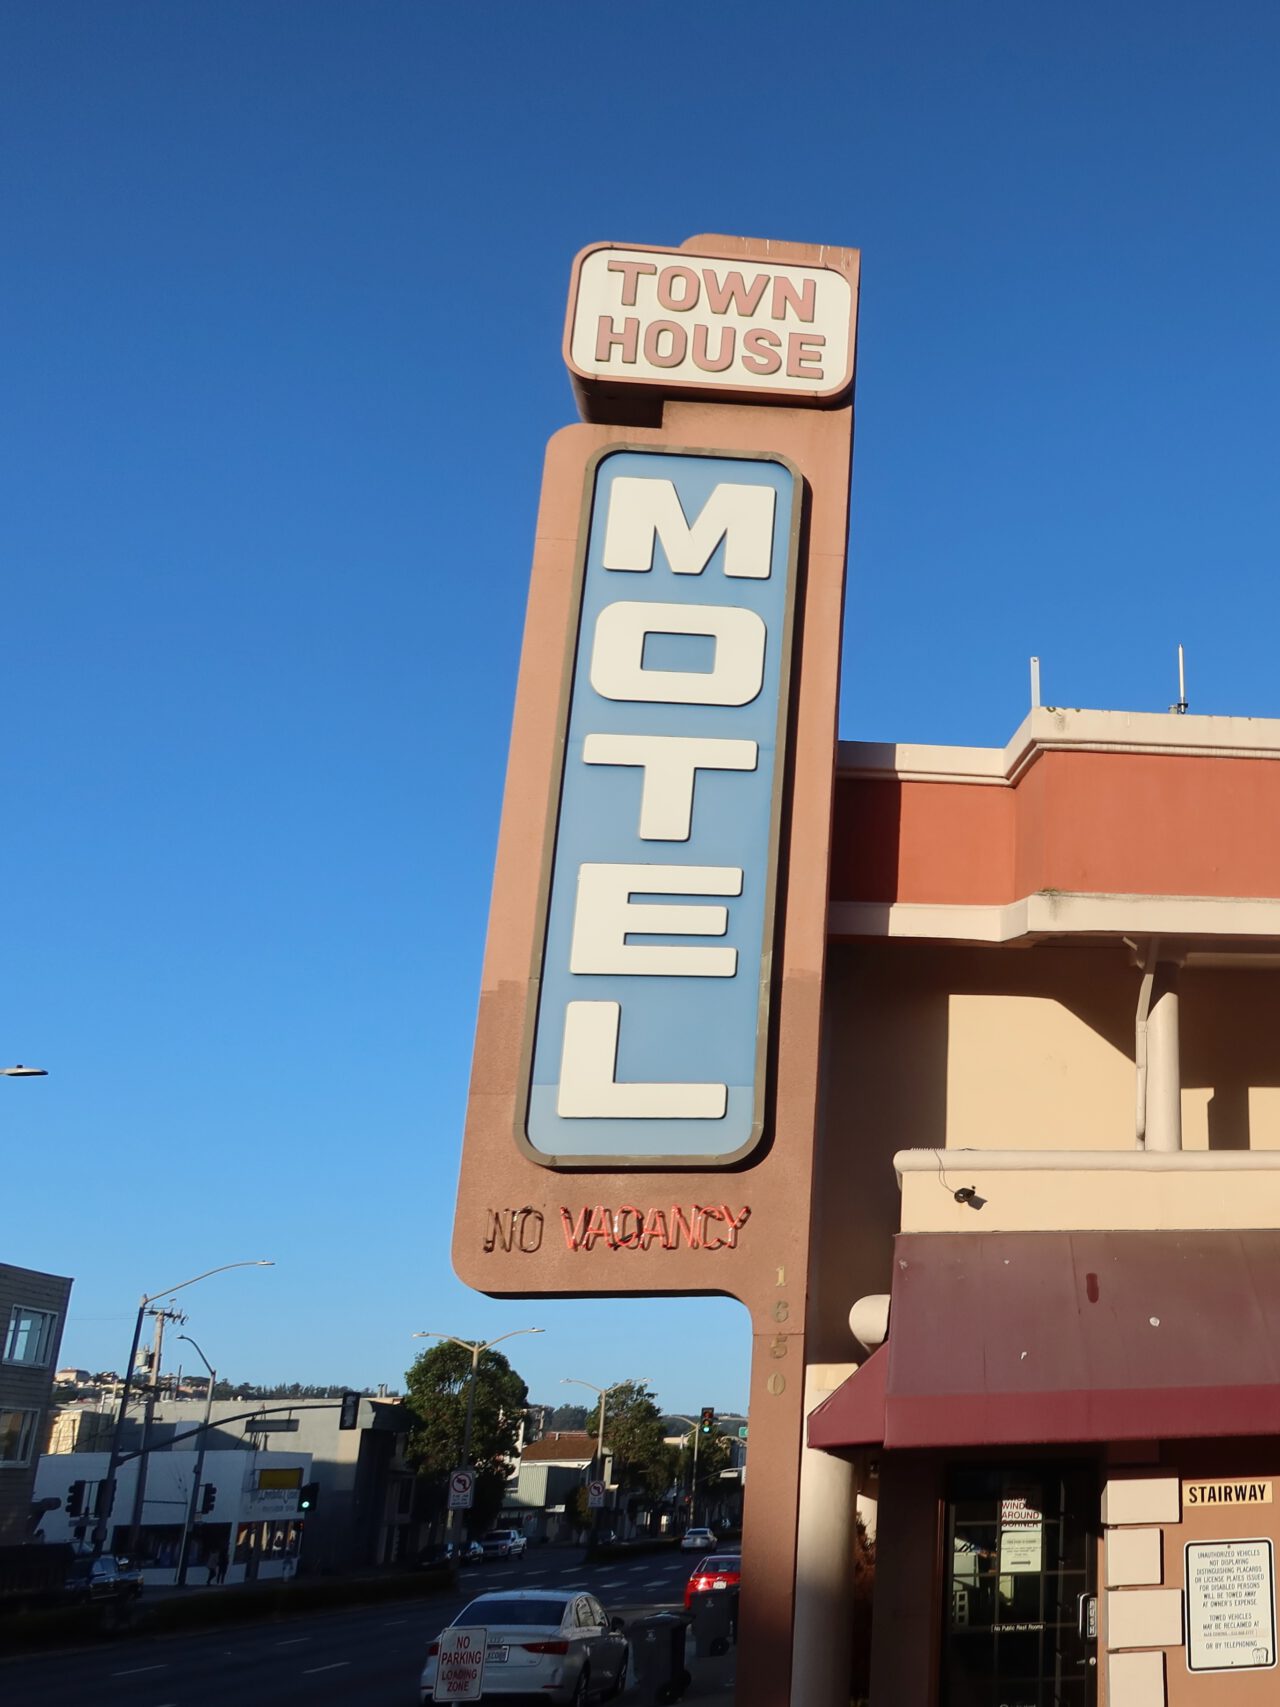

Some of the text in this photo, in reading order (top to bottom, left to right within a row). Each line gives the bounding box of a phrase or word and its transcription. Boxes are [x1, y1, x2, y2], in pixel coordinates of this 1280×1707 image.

[607, 259, 816, 323] TOWN
[594, 315, 827, 380] HOUSE
[557, 476, 777, 1119] MOTEL
[484, 1203, 753, 1254] NO VACANCY
[766, 1264, 789, 1397] 1650
[1189, 1484, 1266, 1504] STAIRWAY
[1001, 1511, 1040, 1520] AROUND
[1197, 1549, 1260, 1559] UNAUTHORIZED VEHICLES
[1220, 1558, 1249, 1566] DISPLAYING
[1196, 1565, 1262, 1576] DISTINGUISHING PLACARDS
[1203, 1575, 1225, 1583] LICENSE
[1226, 1574, 1245, 1582] PLATES
[1246, 1573, 1265, 1581] ISSUED
[1199, 1582, 1260, 1592] FOR DISABLED PERSONS
[1226, 1591, 1243, 1599] TOWED
[1210, 1600, 1233, 1608] OWNER'S
[1209, 1612, 1252, 1622] TOWED VEHICLES
[1214, 1622, 1221, 1630] BE
[1223, 1621, 1252, 1629] RECLAIMED
[456, 1636, 471, 1649] NO
[1205, 1642, 1213, 1650] OR
[1224, 1640, 1258, 1649] TELEPHONING
[441, 1650, 482, 1665] PARKING
[441, 1669, 478, 1681] LOADING
[447, 1680, 470, 1692] ZONE
